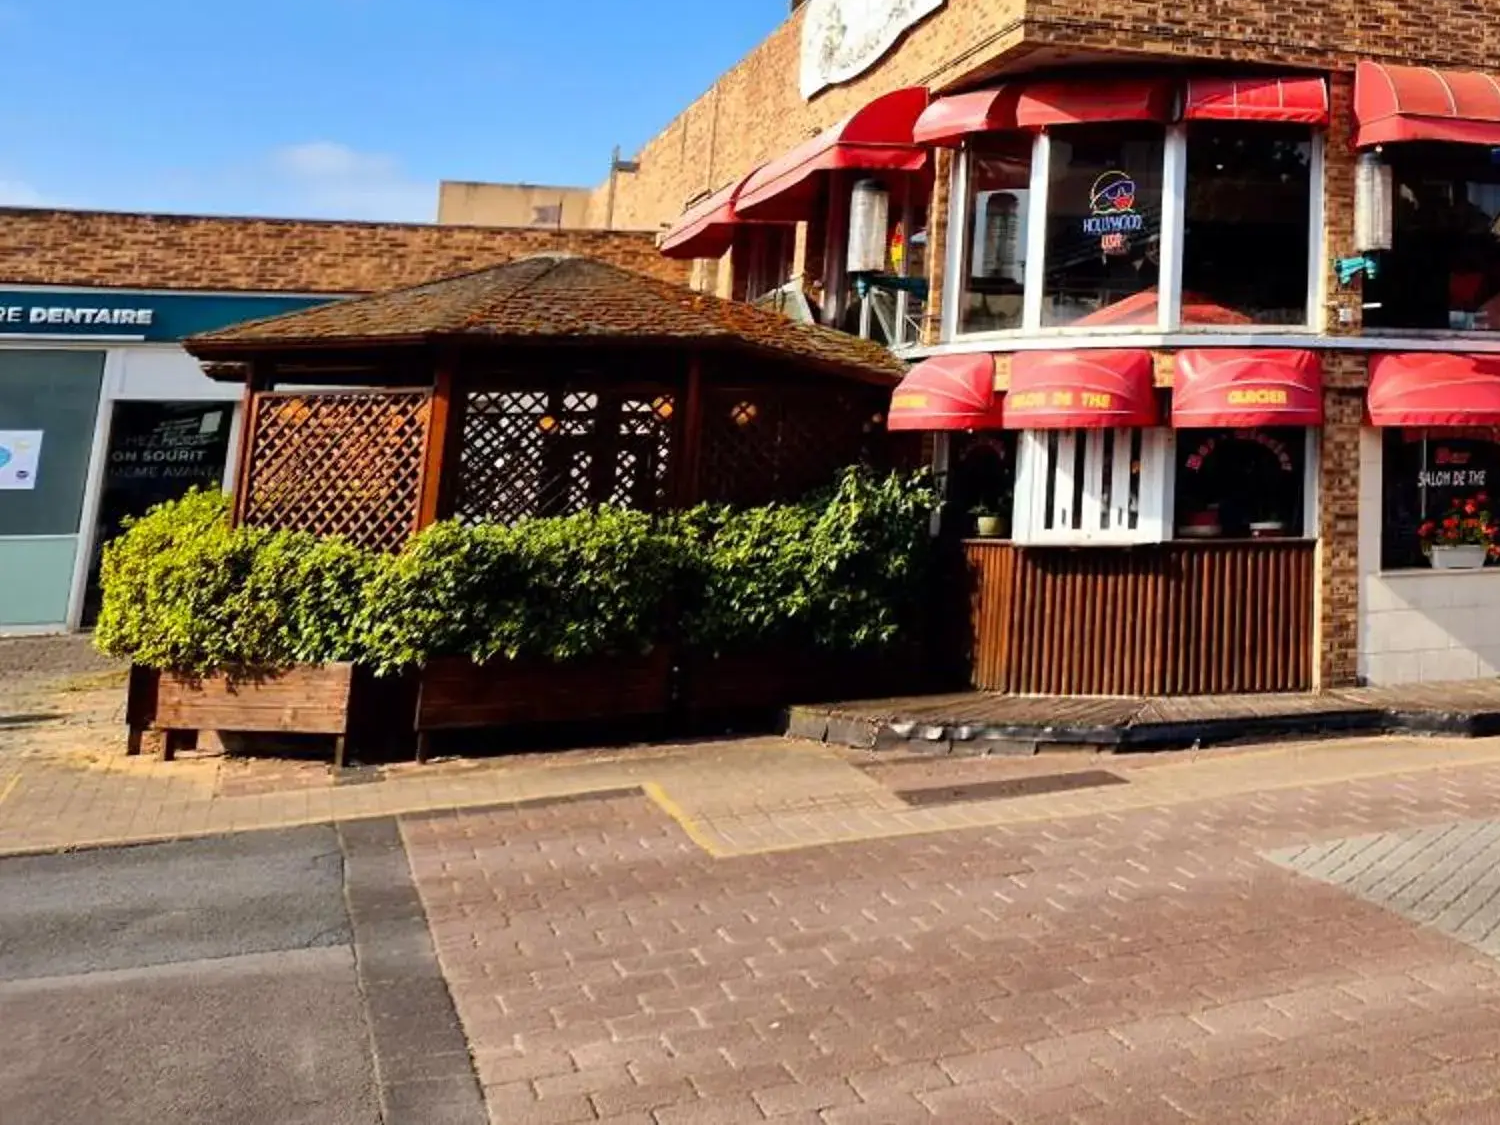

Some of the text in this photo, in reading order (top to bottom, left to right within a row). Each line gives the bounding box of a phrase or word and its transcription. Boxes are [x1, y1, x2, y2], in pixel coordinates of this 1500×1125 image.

[1083, 214, 1142, 233] HOLLYWOOD
[29, 307, 153, 324] DENTAIRE
[112, 450, 206, 462] ON SOURIT
